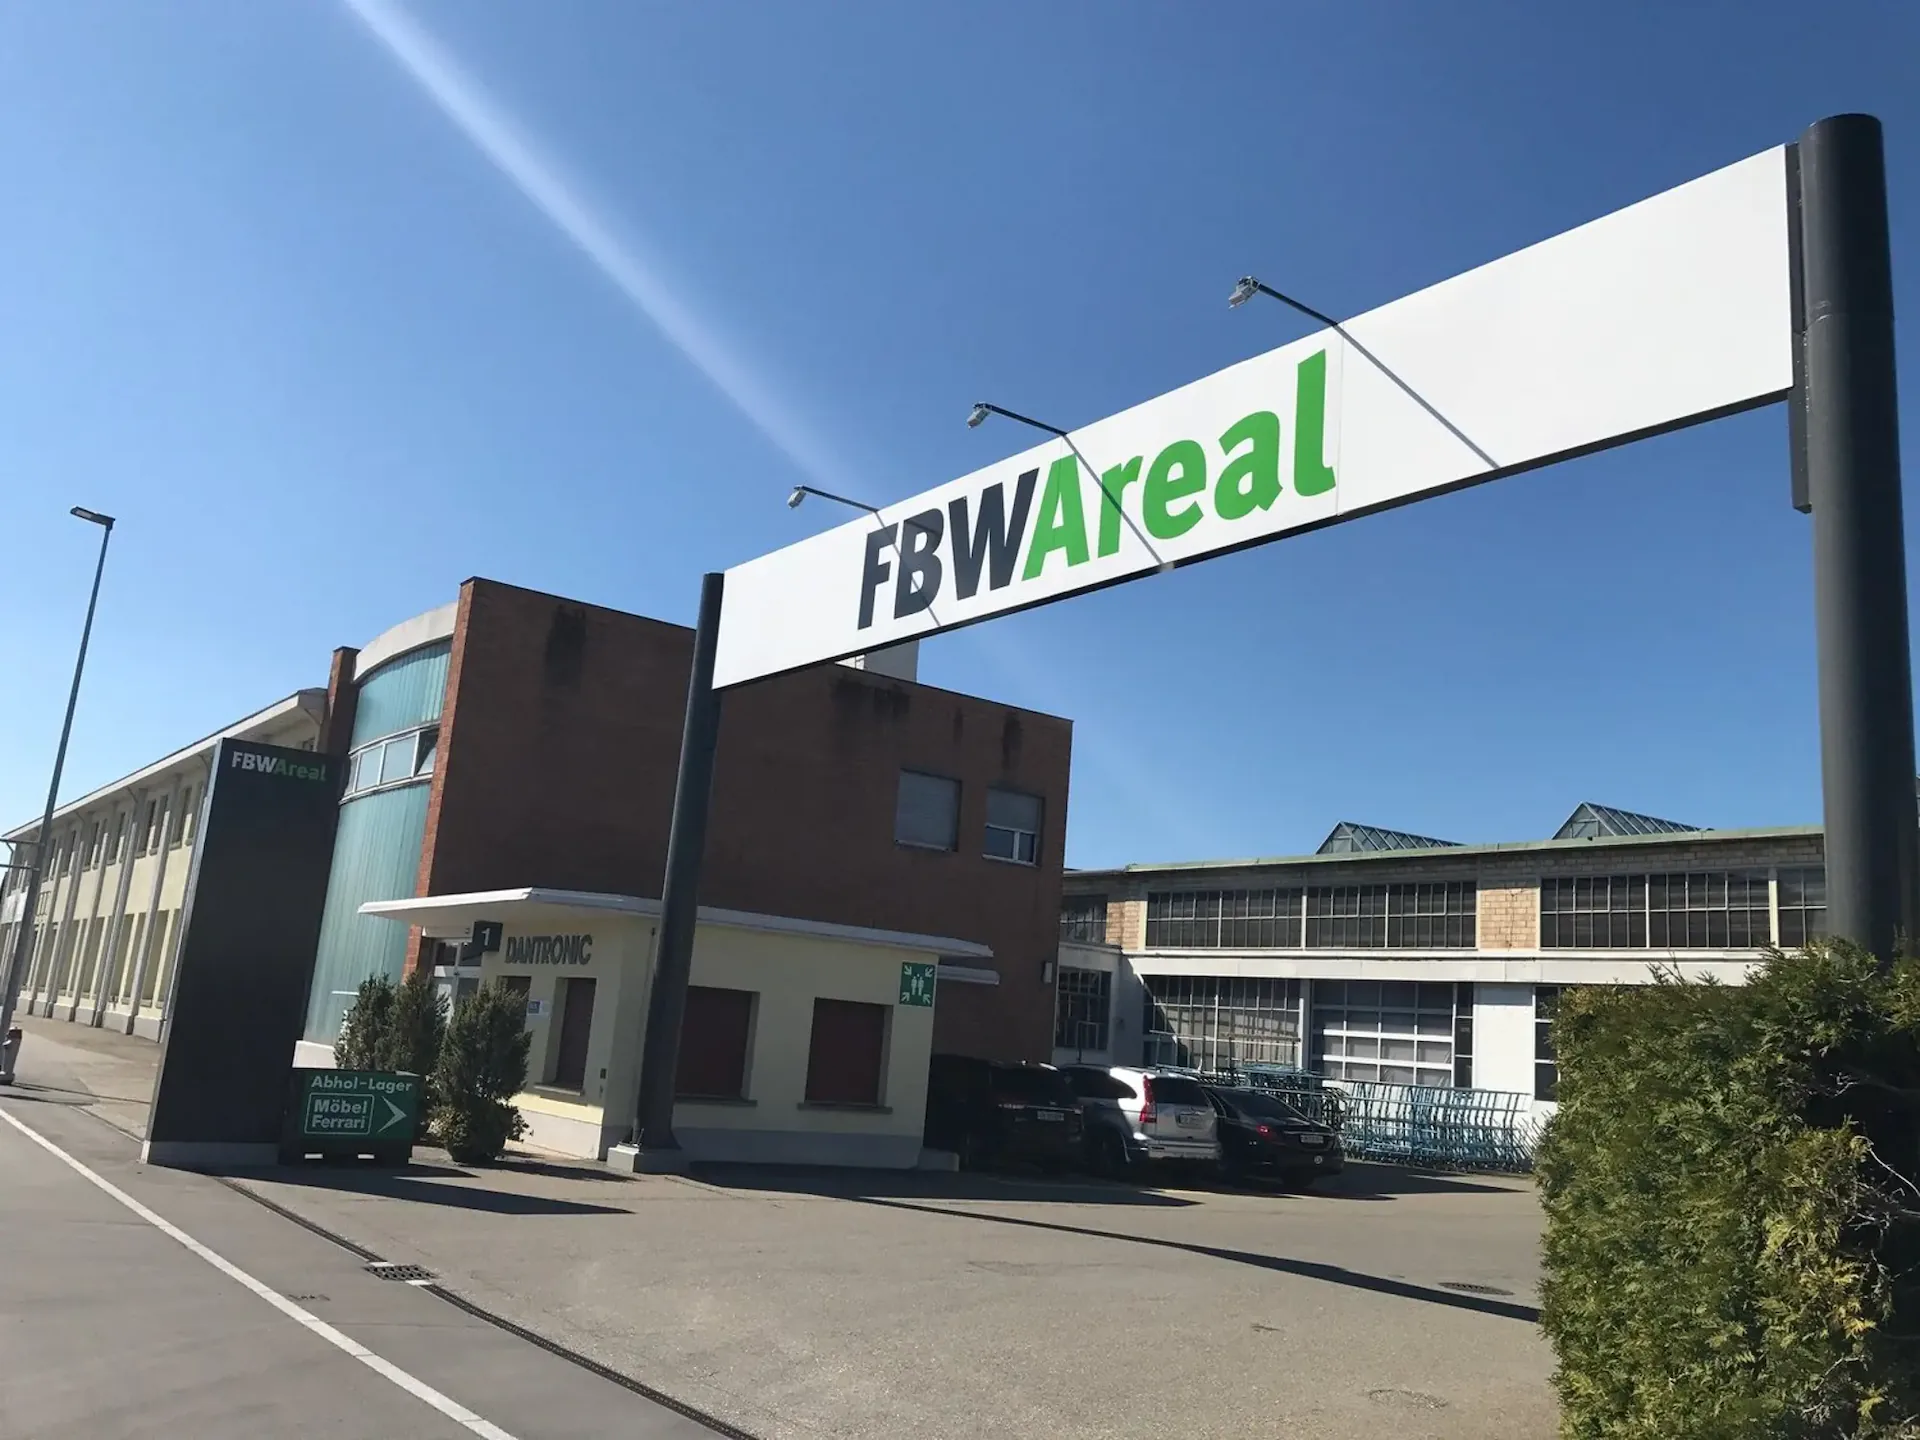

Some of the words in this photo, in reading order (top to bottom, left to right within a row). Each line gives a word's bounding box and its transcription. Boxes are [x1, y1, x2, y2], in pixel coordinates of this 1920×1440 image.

[857, 349, 1336, 630] FBWAreal
[231, 751, 327, 781] FBWAreal
[481, 927, 491, 946] 1
[504, 934, 593, 965] DANTRONIC
[311, 1075, 413, 1094] Abhol-Lager
[314, 1099, 368, 1114] Möbel
[312, 1114, 366, 1129] Ferrari
